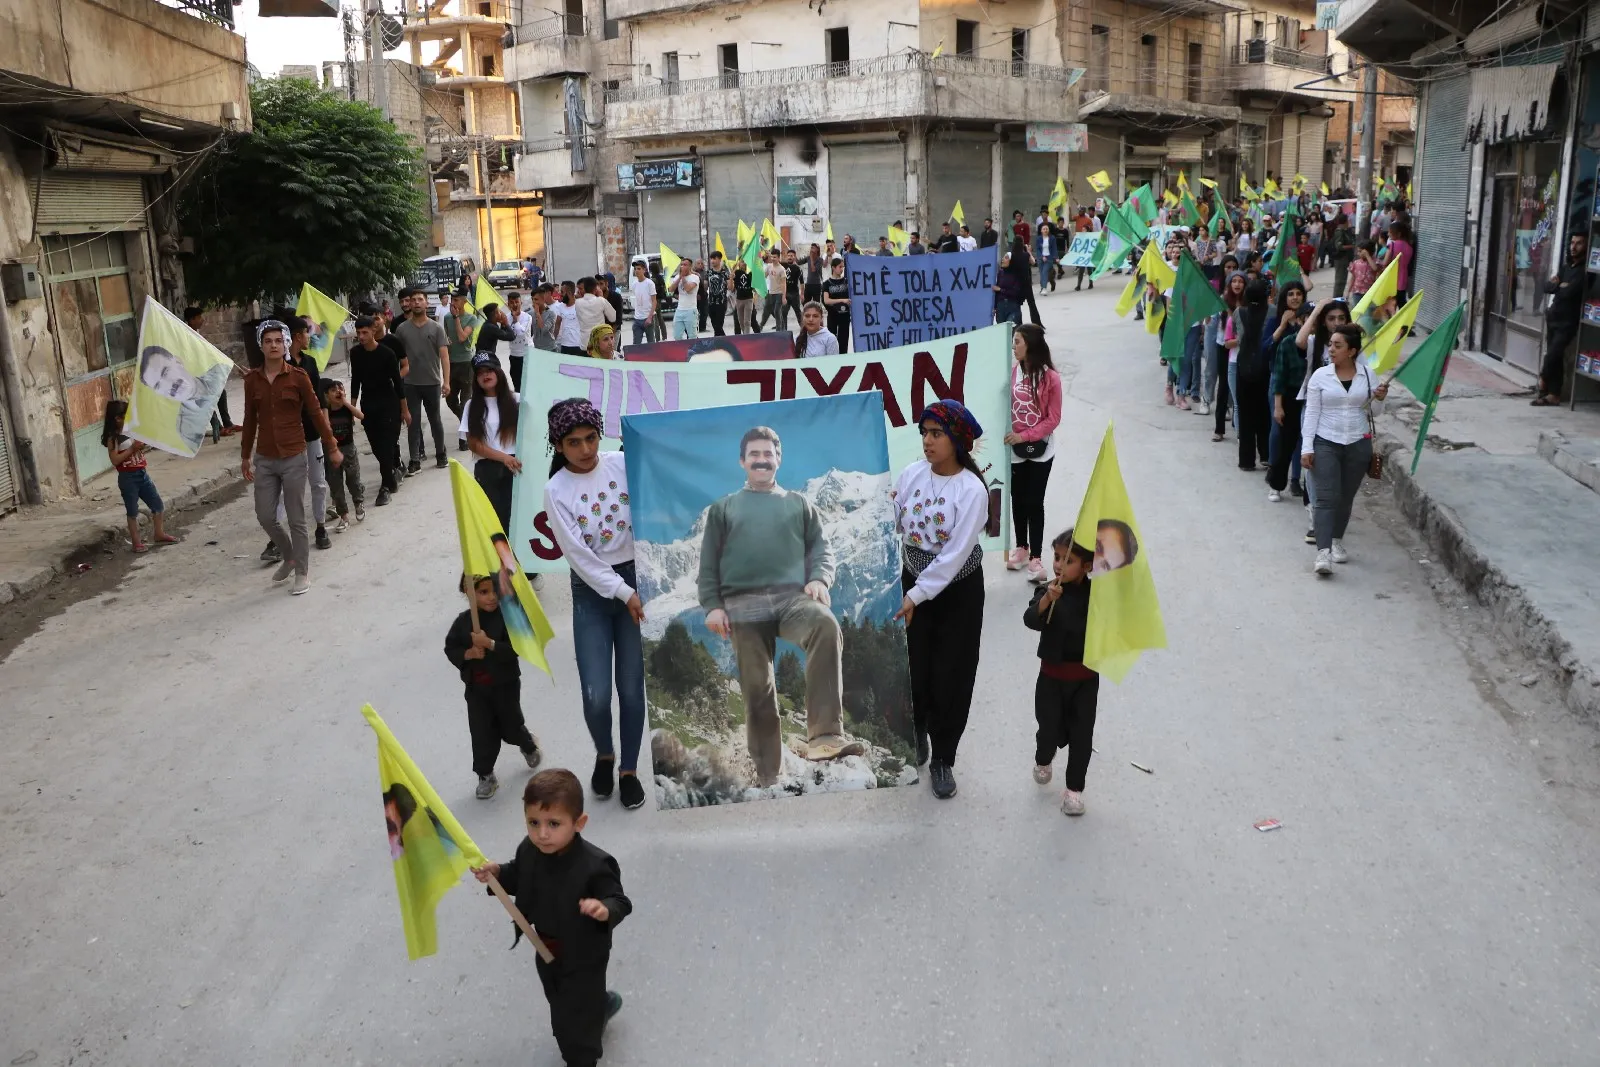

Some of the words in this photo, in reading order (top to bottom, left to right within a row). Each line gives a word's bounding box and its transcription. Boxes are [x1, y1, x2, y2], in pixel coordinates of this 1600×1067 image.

[898, 268, 942, 293] TOLA
[950, 263, 992, 291] XWE
[863, 301, 881, 327] BI
[553, 363, 680, 439] JIN
